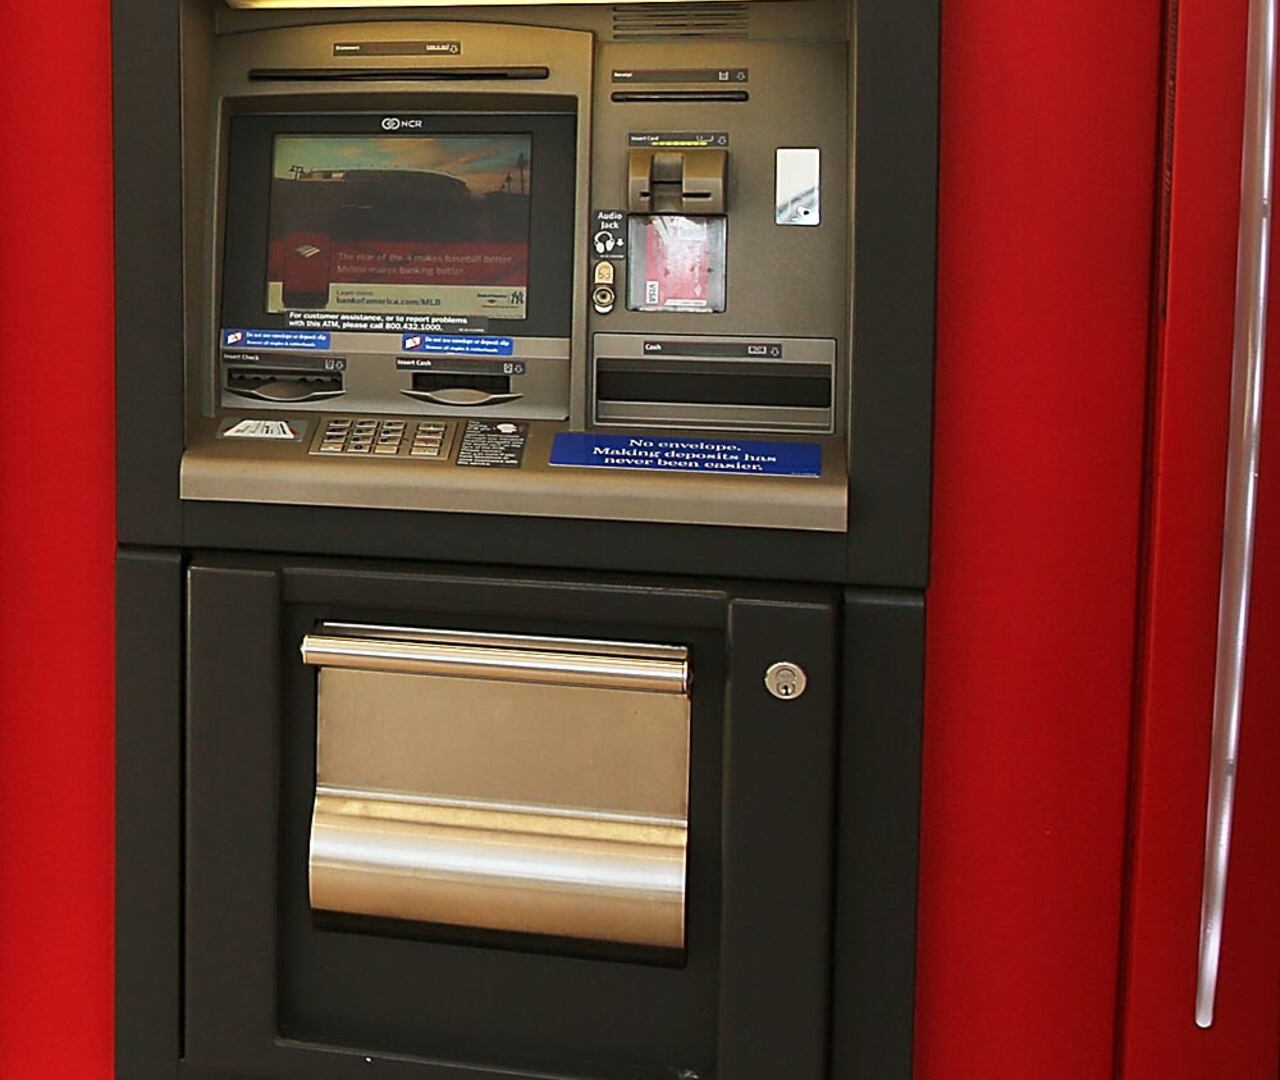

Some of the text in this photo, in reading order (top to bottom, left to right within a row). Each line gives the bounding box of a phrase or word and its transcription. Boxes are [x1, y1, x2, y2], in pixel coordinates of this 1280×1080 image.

[598, 212, 623, 220] Audio
[290, 312, 302, 320] For
[303, 312, 339, 320] customer
[341, 314, 384, 322] assistance,
[406, 316, 430, 324] report
[432, 316, 467, 325] problems
[306, 320, 320, 328] this
[322, 321, 340, 329] ATM,
[342, 321, 368, 330] please
[386, 322, 442, 331] 800.432.1000.
[630, 439, 741, 452] No envelope.
[593, 447, 776, 462] Making deposits has
[604, 457, 762, 471] never been easier.
